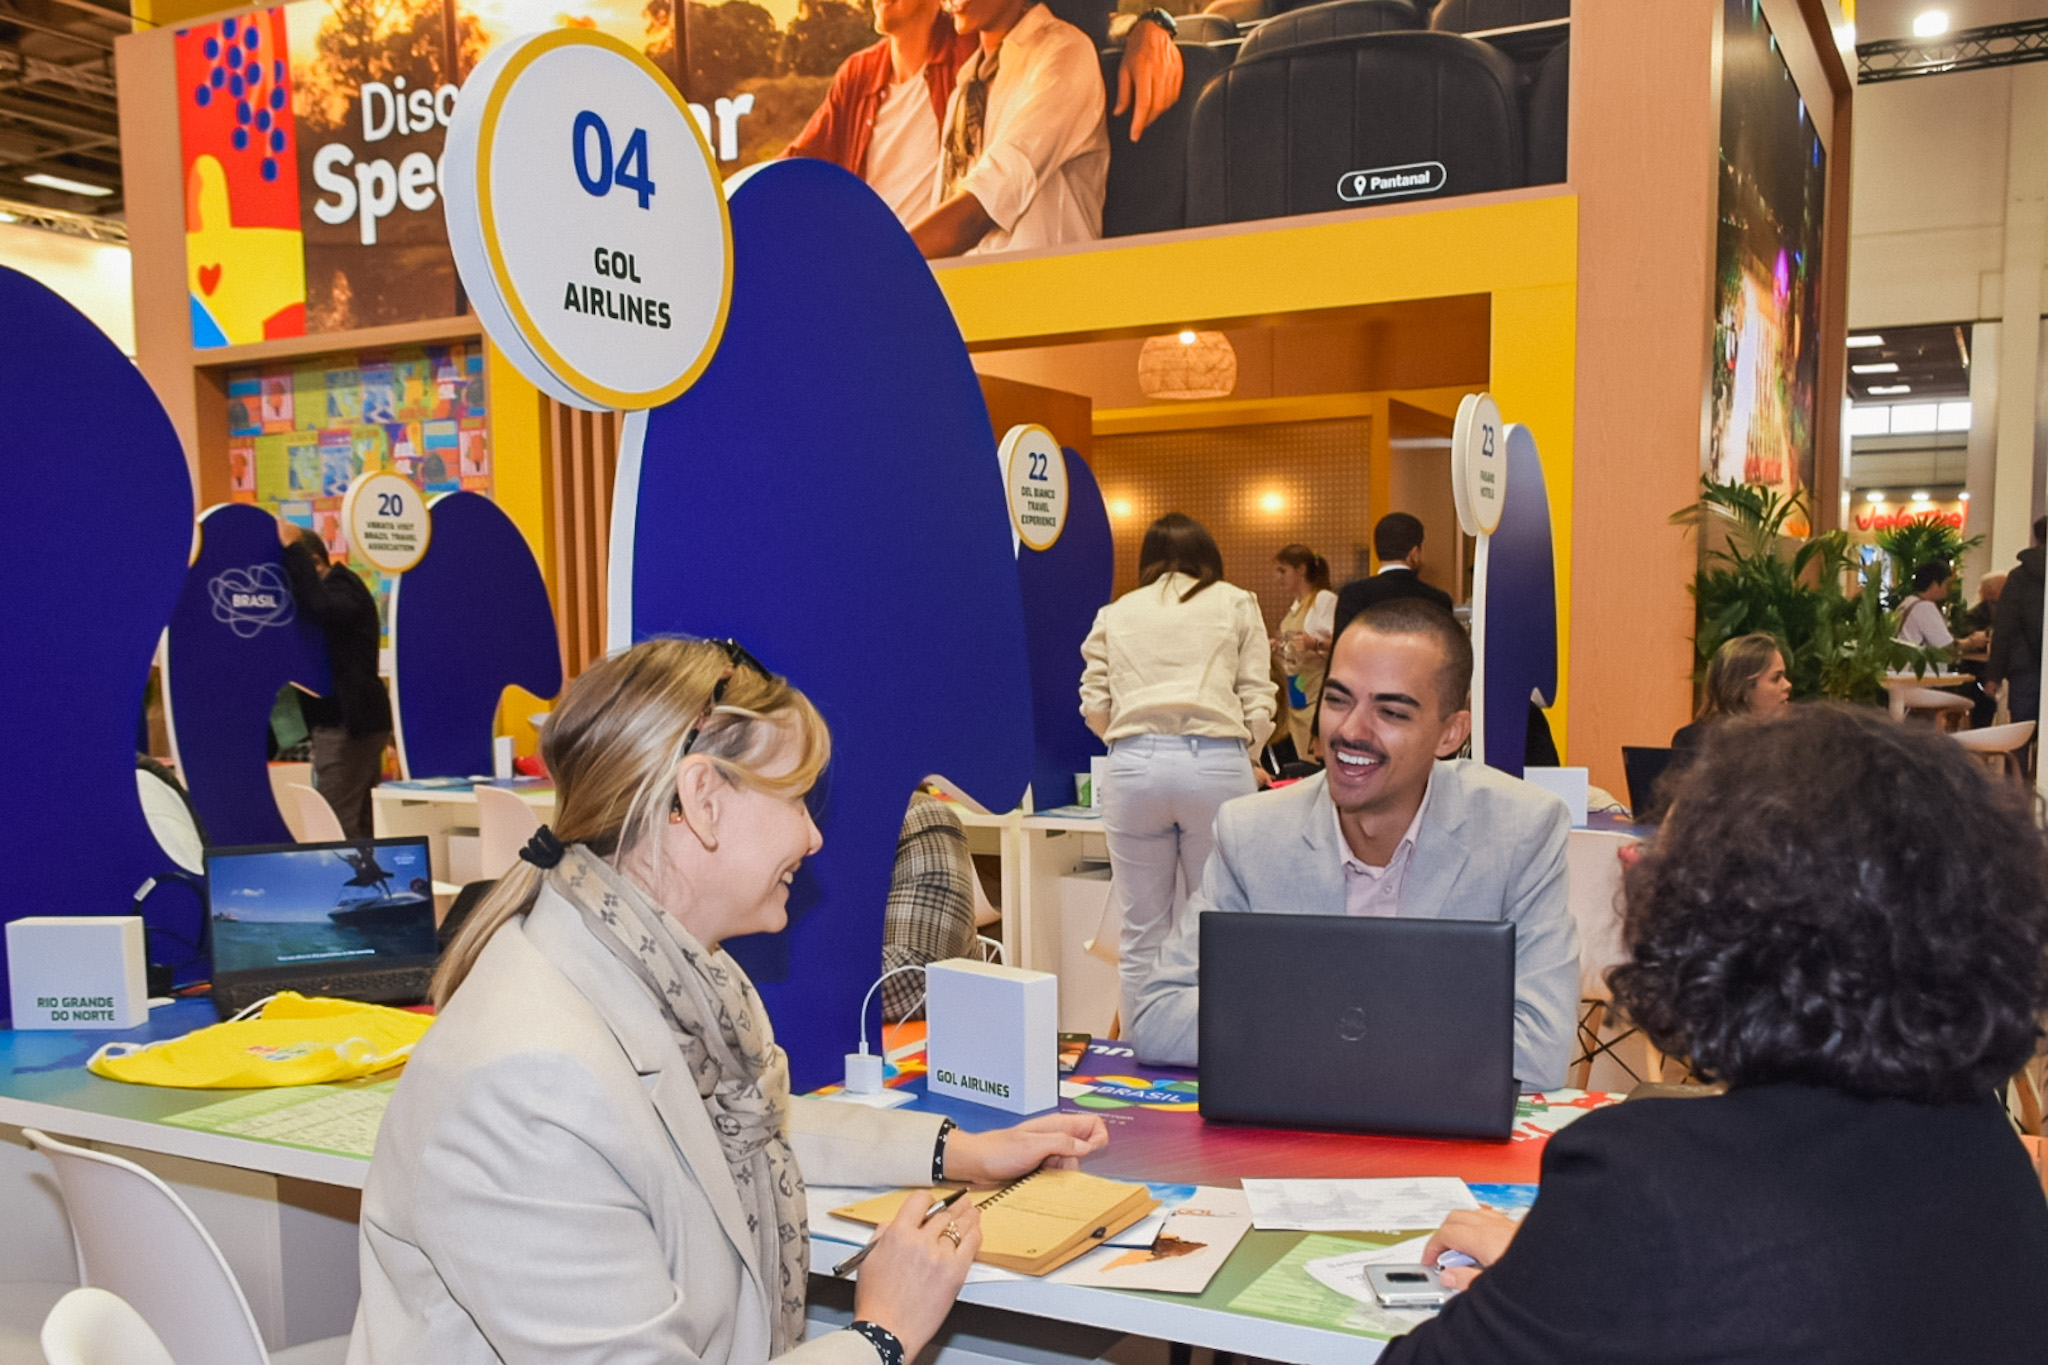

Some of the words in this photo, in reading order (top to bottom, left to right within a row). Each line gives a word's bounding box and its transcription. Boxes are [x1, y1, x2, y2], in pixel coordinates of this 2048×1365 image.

[573, 110, 655, 210] 04
[1370, 170, 1430, 191] Pantanal
[313, 143, 445, 246] Spe
[594, 247, 641, 284] GOL
[564, 282, 672, 330] AIRLINES
[1482, 424, 1495, 457] 23
[1029, 452, 1048, 481] 22
[378, 493, 403, 517] 20
[1027, 501, 1049, 512] TRAVEL
[1021, 514, 1056, 527] EXPERIENCE
[232, 594, 278, 608] BRASIL
[37, 997, 59, 1008] RIO
[61, 997, 115, 1008] GRANDE
[51, 1010, 70, 1021] DO
[72, 1010, 116, 1021] NORTE
[936, 1069, 958, 1086] GOL
[960, 1075, 1010, 1098] AIRLINES
[1095, 1085, 1181, 1103] BRASIL
